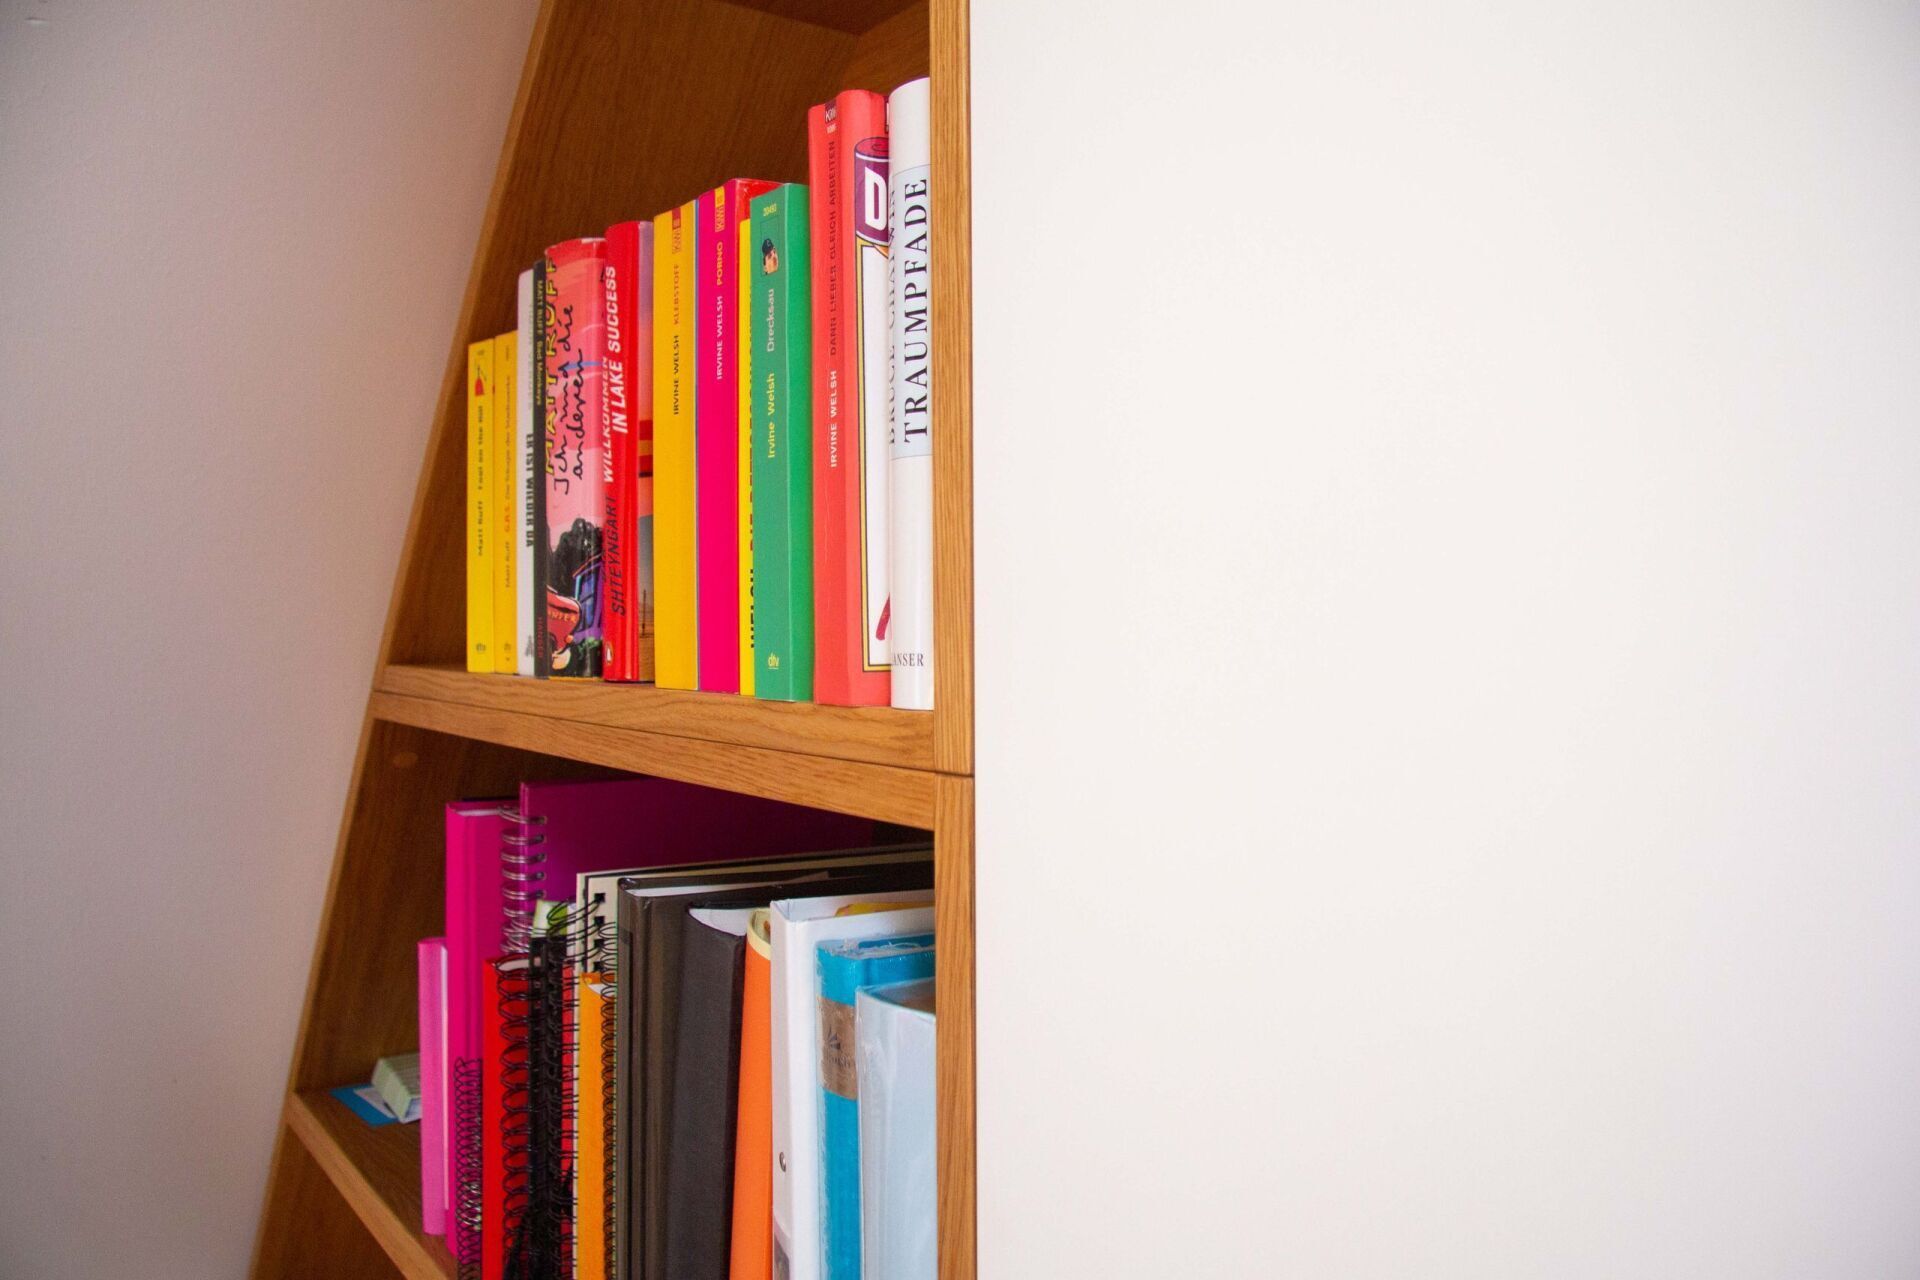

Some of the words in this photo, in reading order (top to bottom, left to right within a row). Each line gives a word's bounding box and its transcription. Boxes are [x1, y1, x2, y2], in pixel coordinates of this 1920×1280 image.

[557, 304, 573, 352] die
[606, 266, 622, 353] SUCCESS
[767, 288, 775, 352] Drecksau
[904, 178, 928, 443] TRAUMPFADE
[557, 361, 570, 423] und
[565, 348, 586, 480] anderen
[609, 360, 627, 413] LAKE
[602, 357, 614, 483] WILLKOMMEN
[611, 415, 628, 434] IN
[554, 435, 570, 495] Ich
[605, 496, 625, 616] SHTEYNGART
